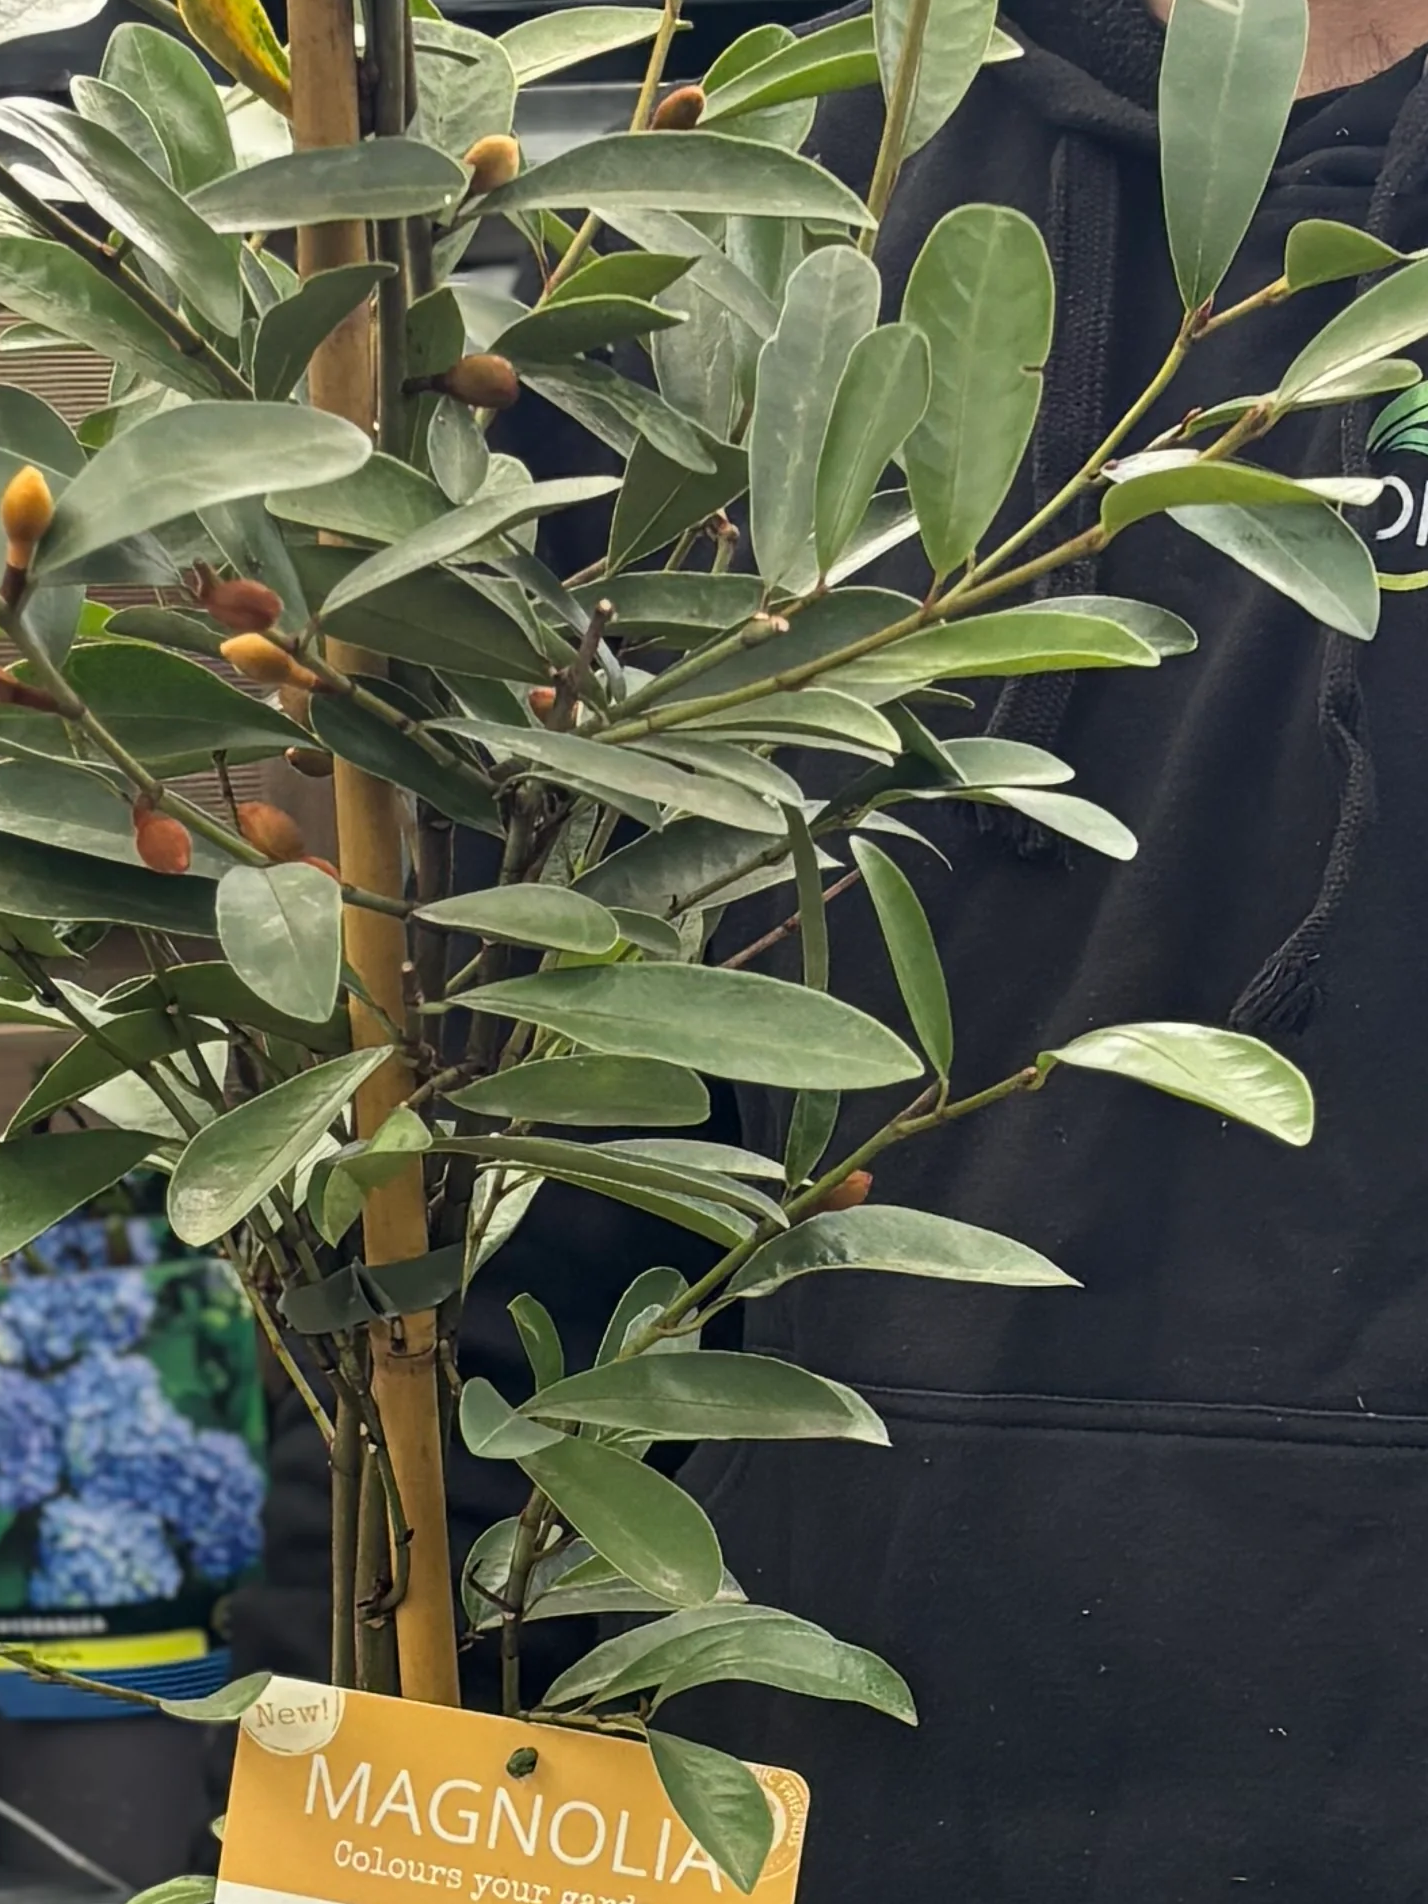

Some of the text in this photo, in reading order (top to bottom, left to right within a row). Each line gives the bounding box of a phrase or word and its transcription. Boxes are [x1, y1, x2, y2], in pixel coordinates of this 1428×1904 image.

[255, 1698, 330, 1729] New!
[304, 1753, 722, 1893] MAGNOLIA
[333, 1839, 464, 1890] Colours
